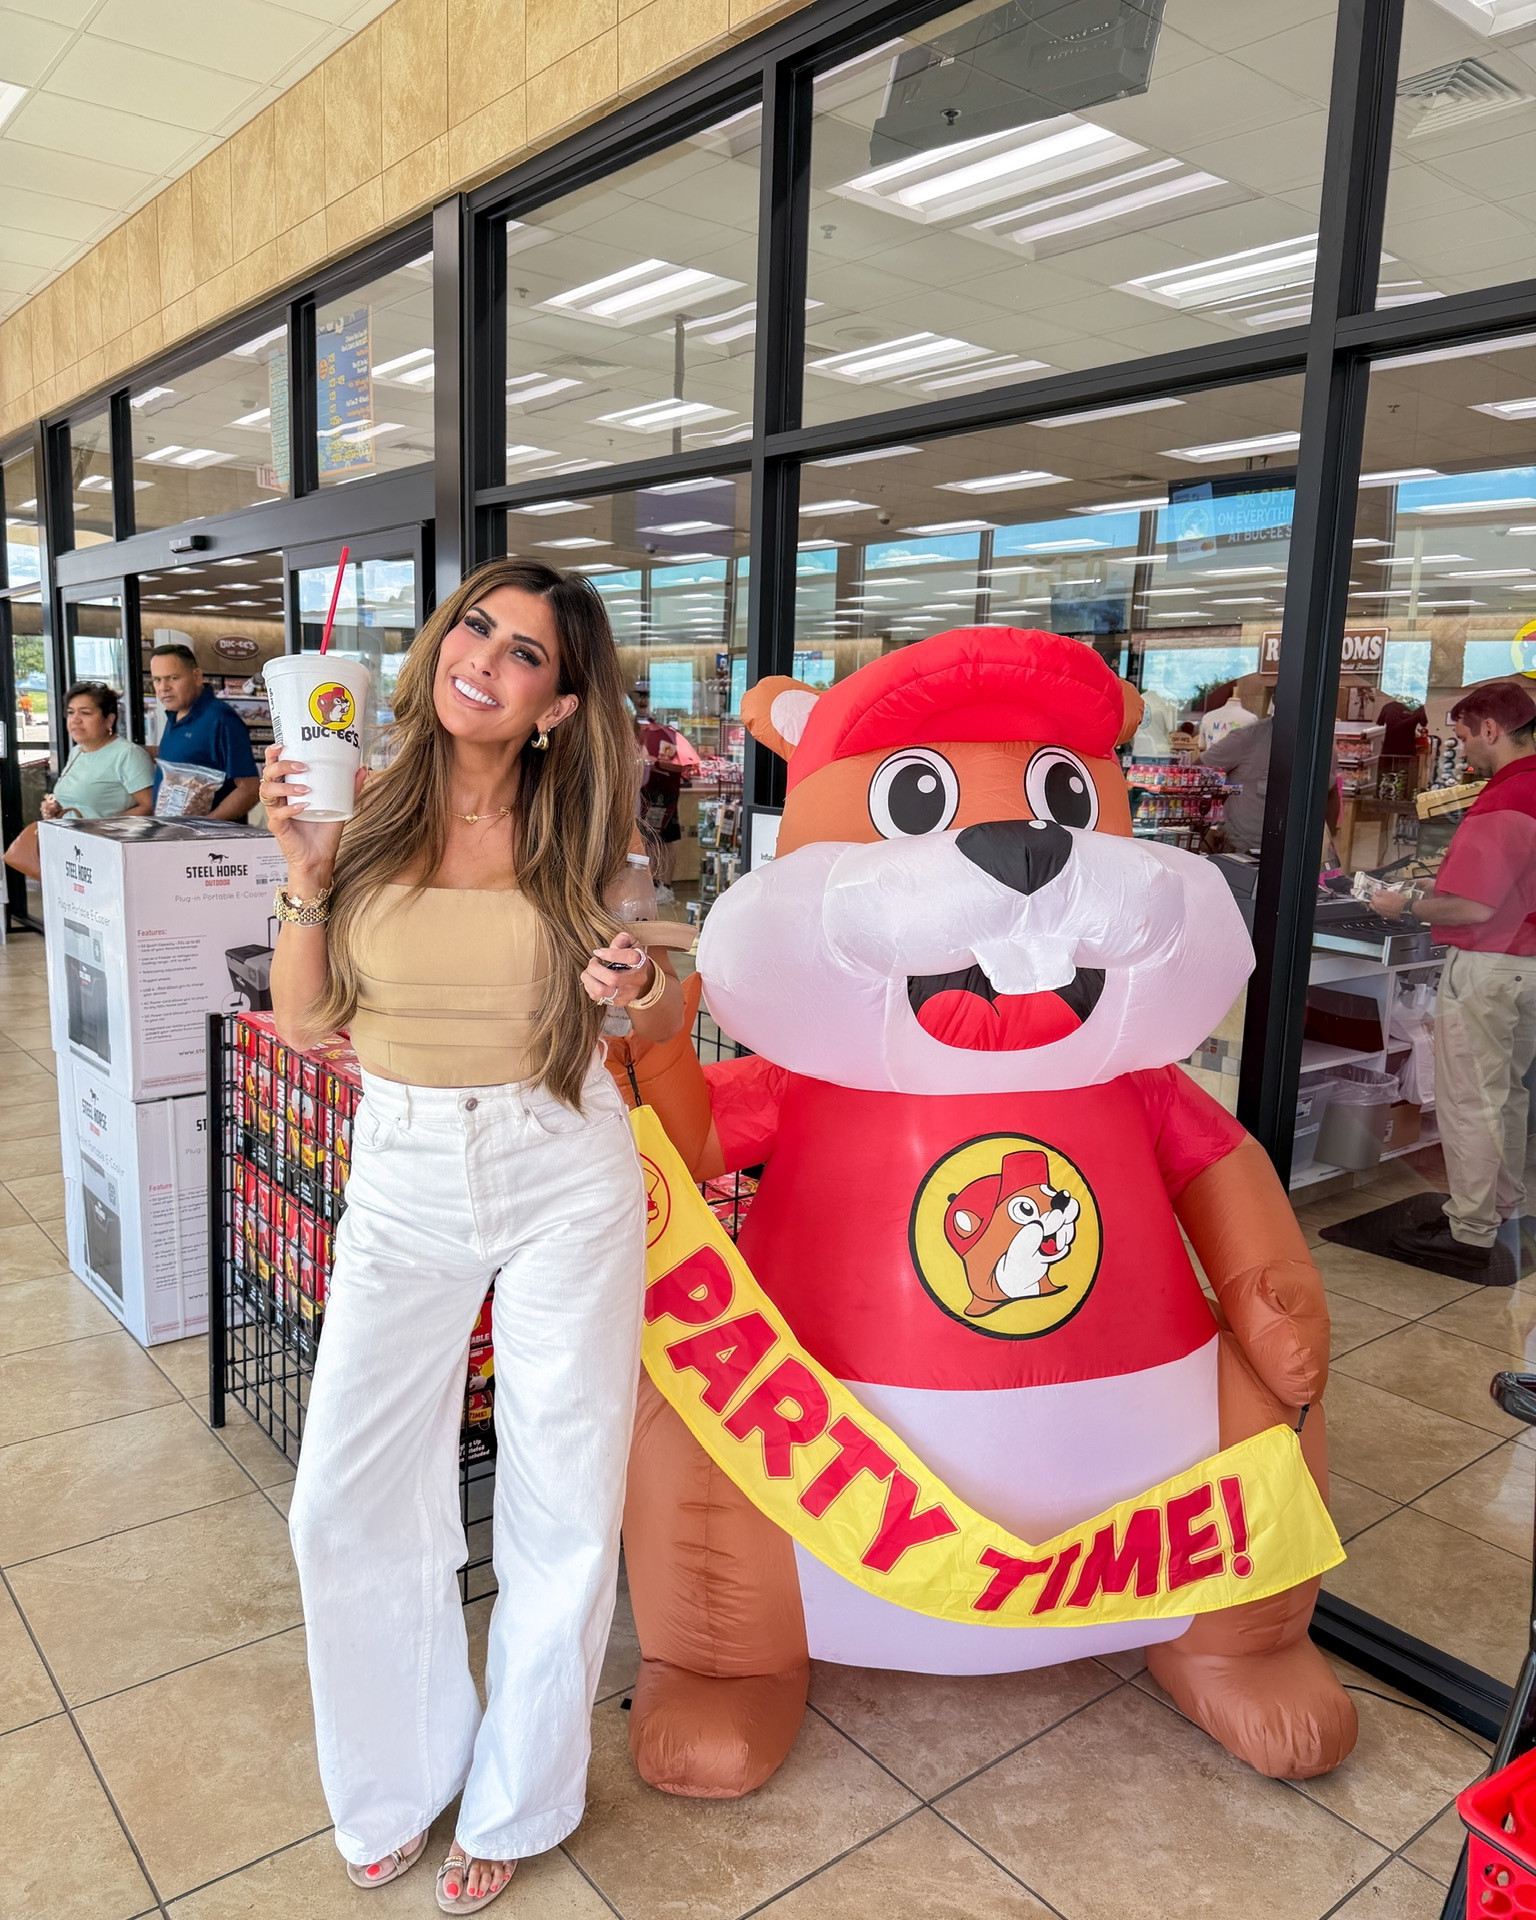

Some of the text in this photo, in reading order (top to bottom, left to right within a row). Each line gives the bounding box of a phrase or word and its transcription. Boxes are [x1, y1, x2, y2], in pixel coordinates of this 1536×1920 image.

[1236, 487, 1290, 508] 5% OFF
[1218, 511, 1234, 526] ON
[1227, 524, 1292, 543] AT BUC-EE'S
[301, 725, 360, 750] BUC-EE'S
[185, 864, 249, 879] STEEL HORSE
[204, 879, 231, 887] OUTDOOR
[174, 890, 268, 903] Plug-in Portable E-Cooler
[137, 929, 168, 937] Features:
[236, 1053, 244, 1148] NFLATABLE
[235, 1195, 244, 1289] INFLTABE
[645, 1244, 1256, 1615] PARTY TIME!
